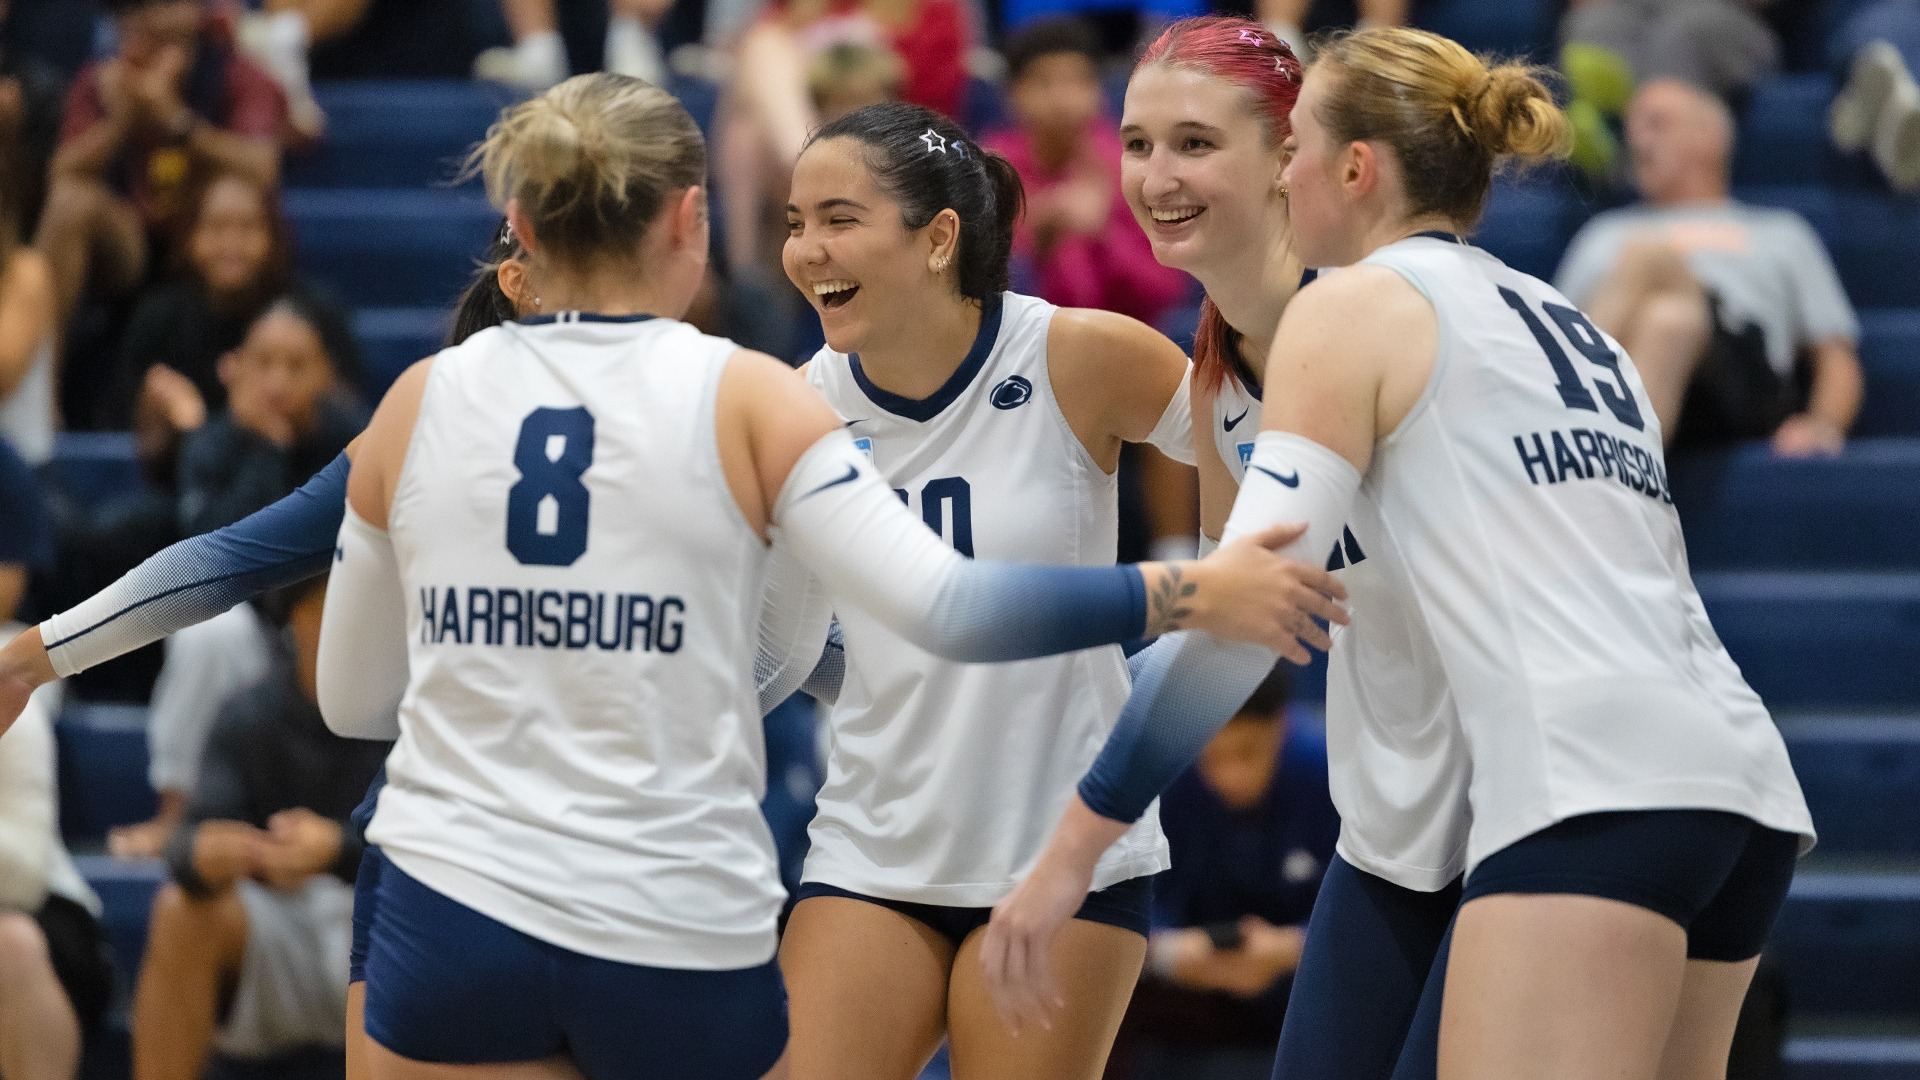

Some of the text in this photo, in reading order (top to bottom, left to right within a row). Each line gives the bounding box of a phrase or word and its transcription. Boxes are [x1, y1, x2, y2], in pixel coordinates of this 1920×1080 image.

[1496, 283, 1645, 433] 19
[505, 404, 596, 567] 8
[892, 475, 975, 561] 0
[420, 585, 685, 654] HARRISBURG
